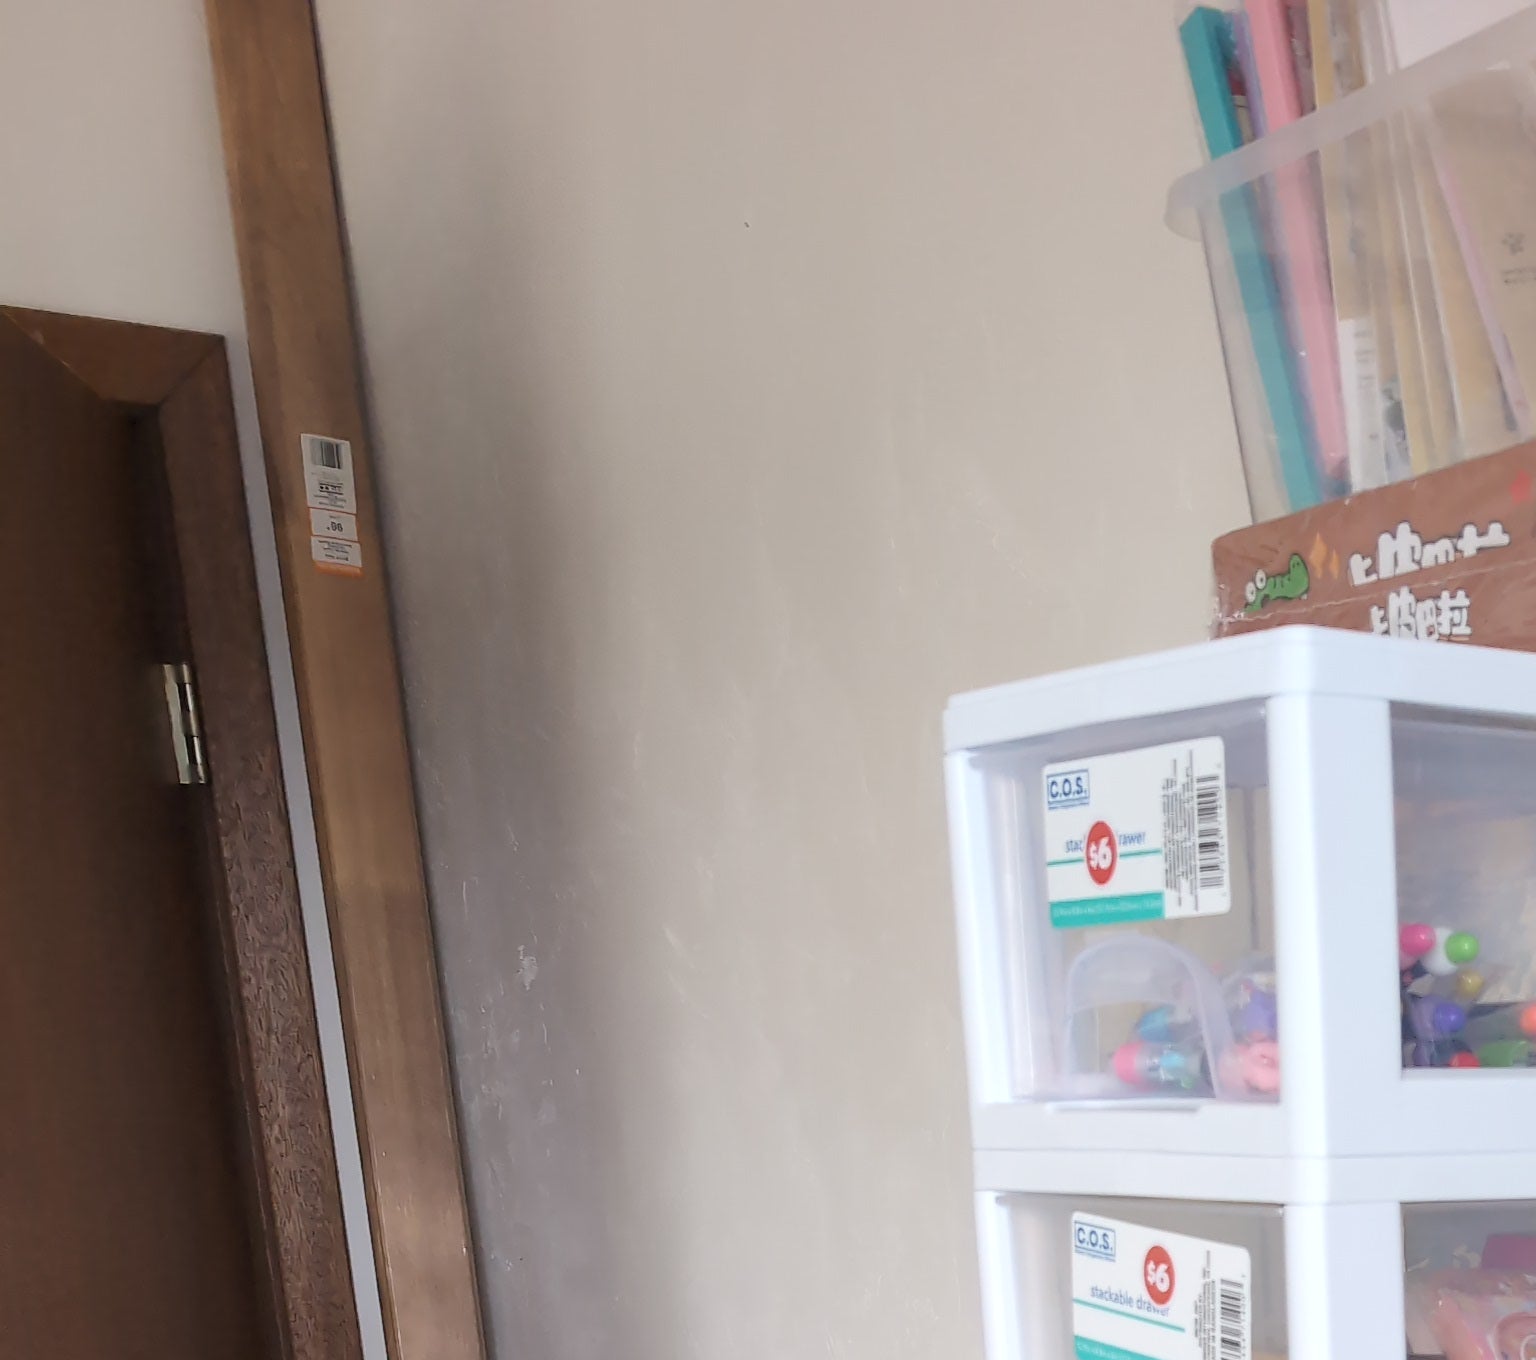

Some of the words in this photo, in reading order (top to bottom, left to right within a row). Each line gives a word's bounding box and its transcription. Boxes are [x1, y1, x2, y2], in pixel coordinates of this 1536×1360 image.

[1050, 776, 1087, 798] C.O.S.
[1088, 836, 1114, 870] $6
[1077, 1227, 1113, 1250] C.O.S.
[1146, 1260, 1170, 1293] $6
[1090, 1285, 1133, 1307] stackable
